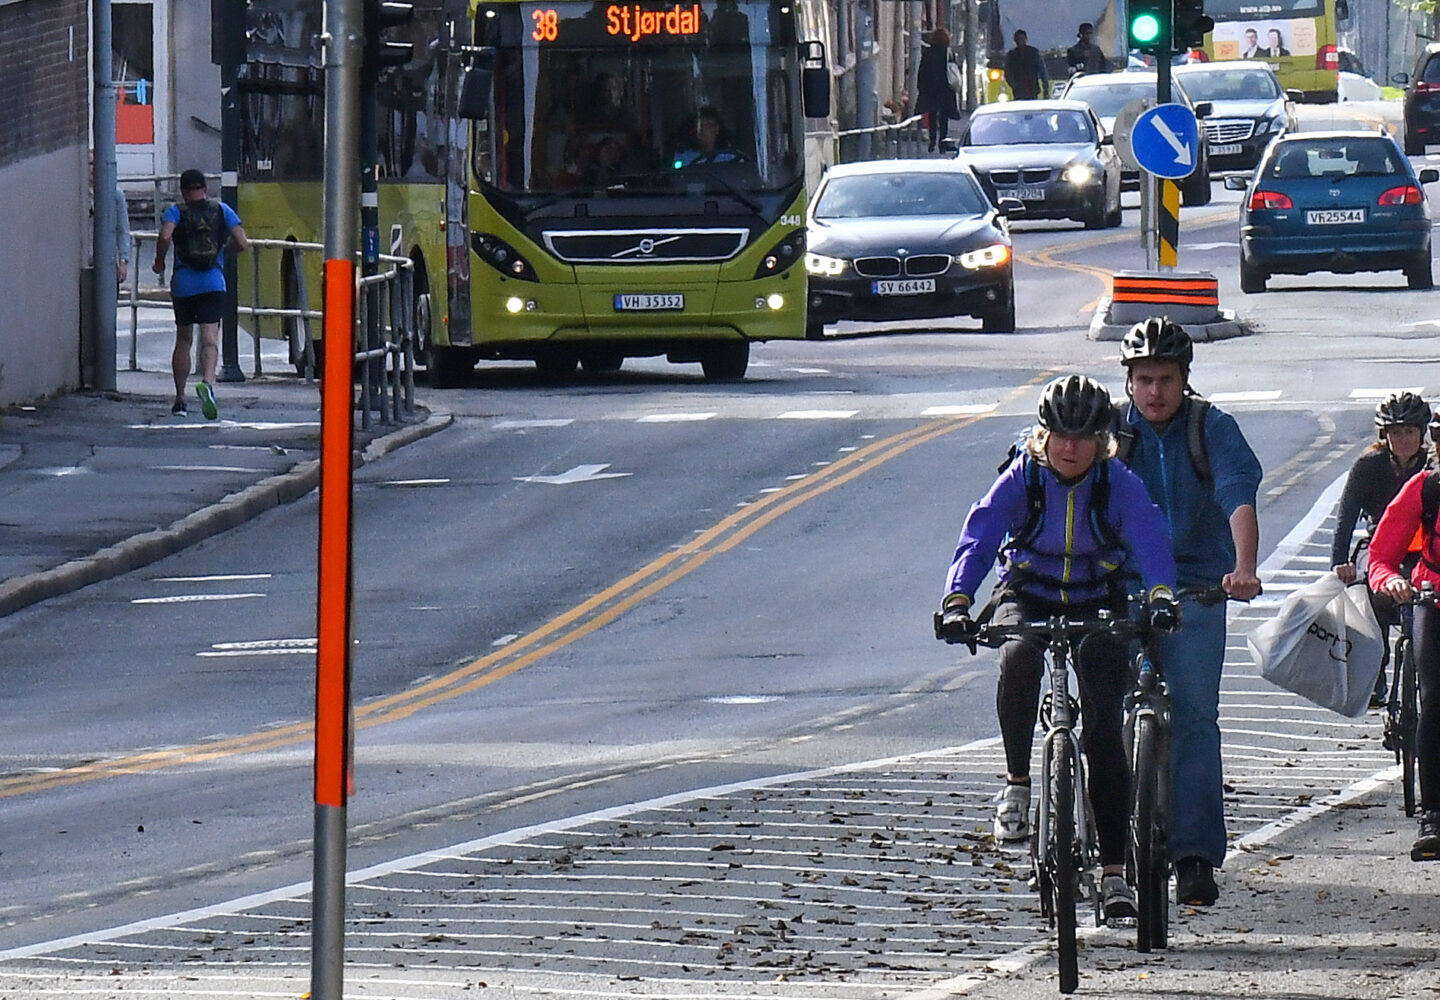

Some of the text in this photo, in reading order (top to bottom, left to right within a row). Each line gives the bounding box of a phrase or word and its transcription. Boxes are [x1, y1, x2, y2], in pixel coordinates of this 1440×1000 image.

[532, 4, 700, 42] 38 Stjørdal
[780, 215, 801, 226] 348
[879, 280, 933, 293] SV 66442
[624, 296, 681, 307] VH 35352
